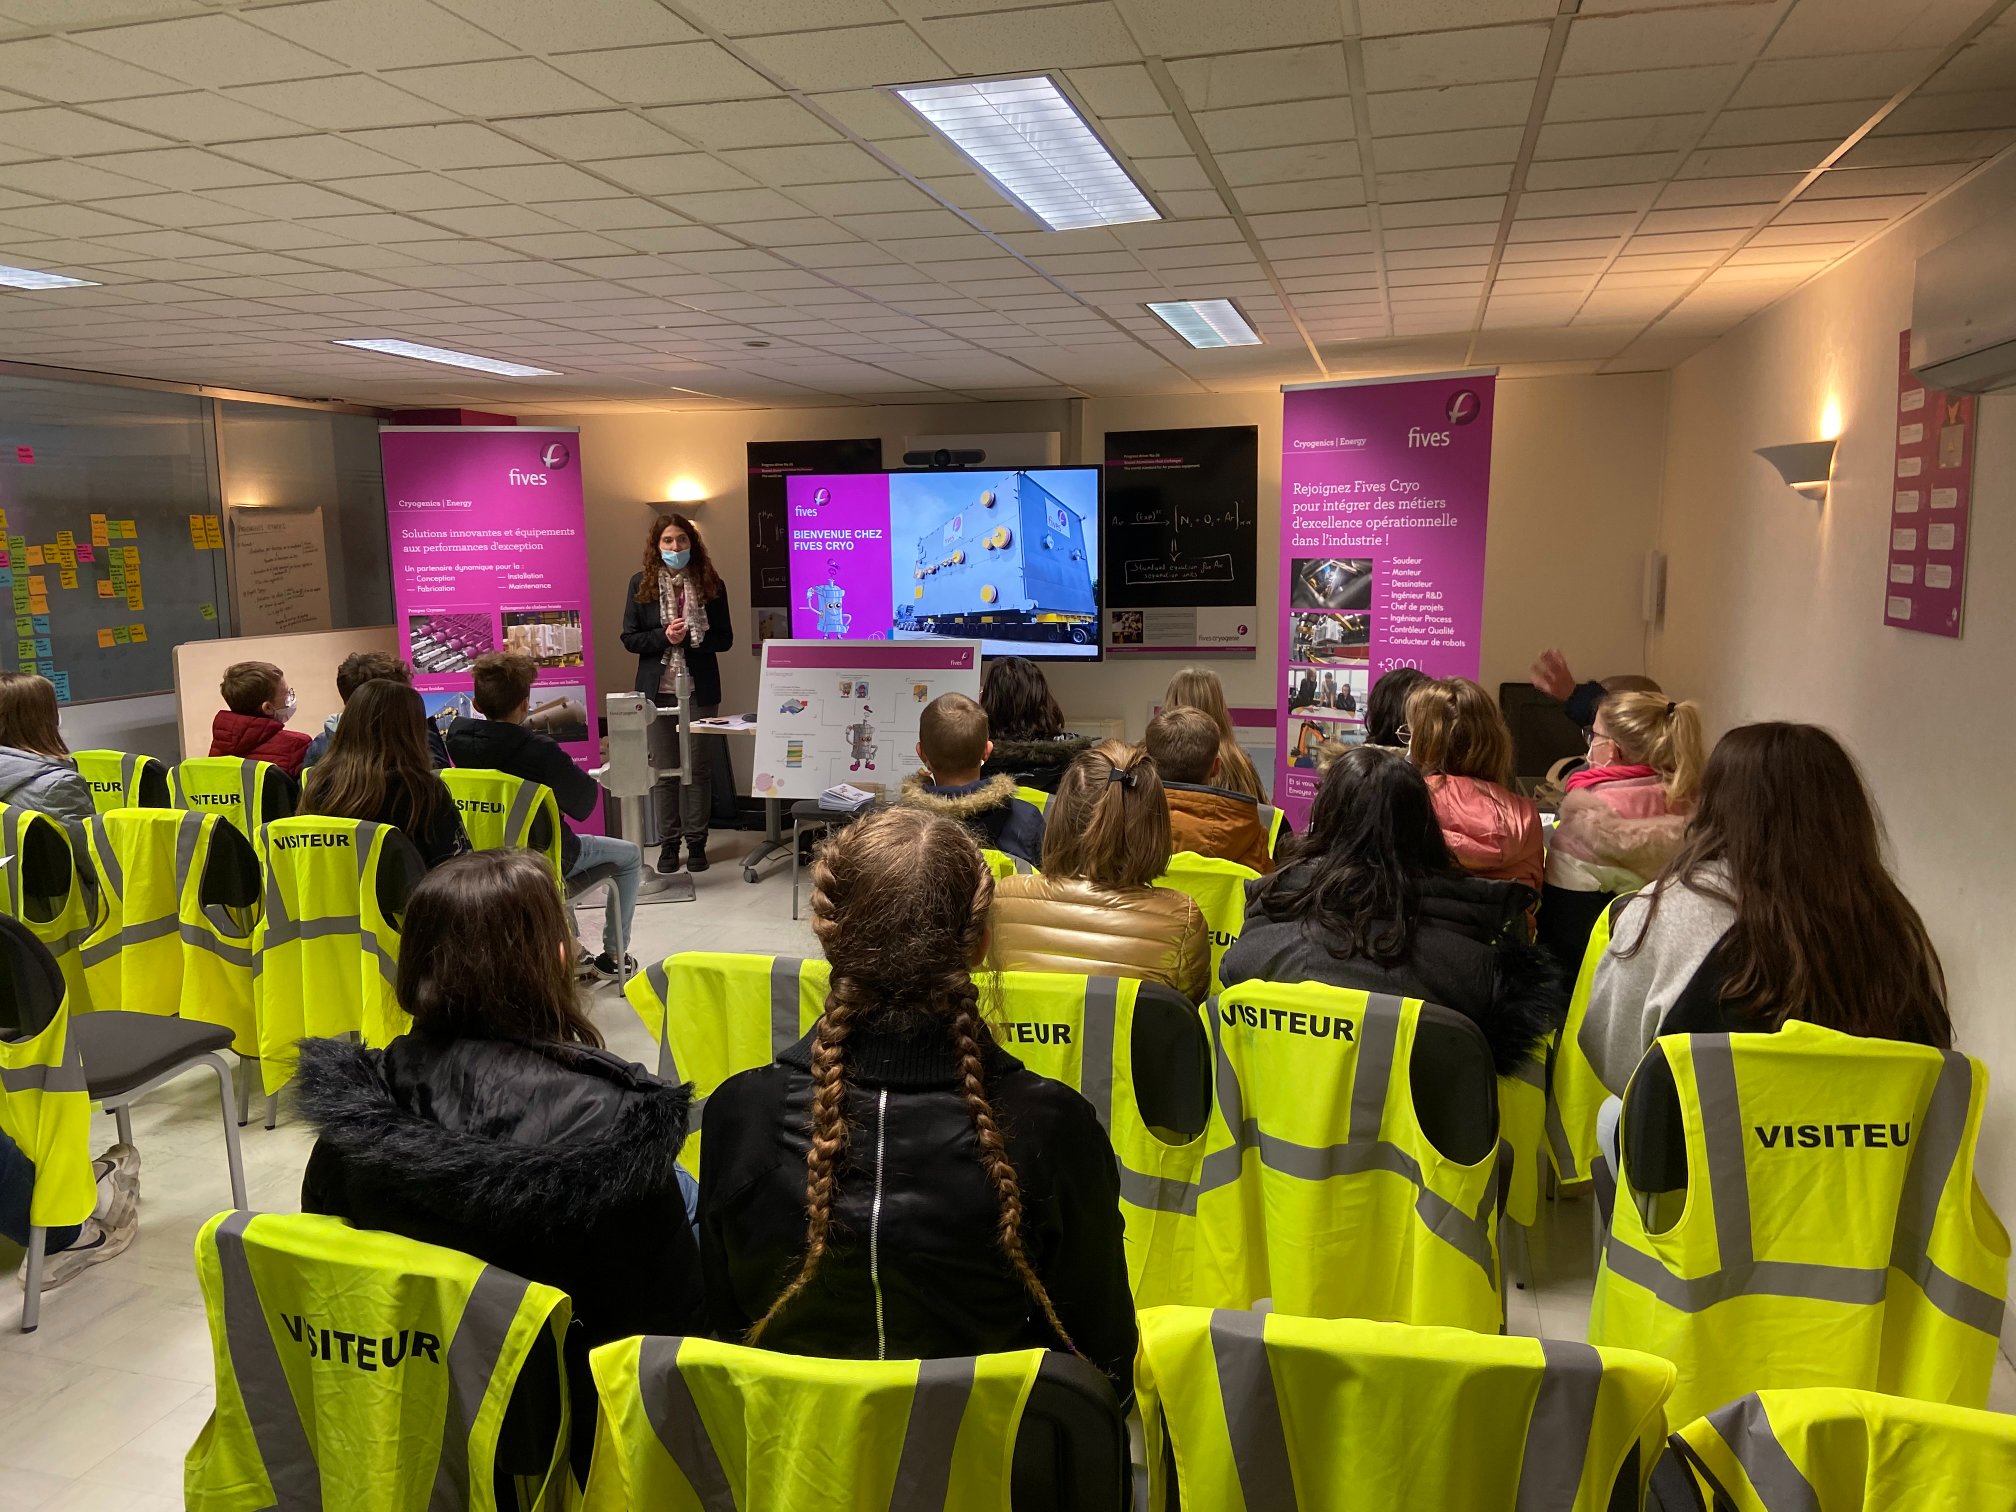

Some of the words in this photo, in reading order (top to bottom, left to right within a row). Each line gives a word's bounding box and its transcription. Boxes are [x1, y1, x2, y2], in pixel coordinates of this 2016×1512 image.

[1408, 427, 1450, 448] fives
[1293, 439, 1334, 449] Cryogenics
[1340, 438, 1367, 446] Energy
[509, 468, 547, 486] fives
[1293, 482, 1351, 497] Rejoignez
[1354, 480, 1386, 492] Fives
[1390, 479, 1420, 494] Cryo
[398, 500, 440, 508] Cryogenics
[446, 500, 472, 508] Energy
[1292, 503, 1320, 514] pour
[1323, 499, 1371, 513] intégrer
[1373, 496, 1395, 510] des
[1398, 497, 1446, 509] métiers
[795, 505, 817, 516] fives
[1292, 515, 1363, 528] d'excellence
[1366, 513, 1458, 530] opérationnelle
[402, 529, 447, 538] Solutions
[450, 529, 502, 537] innovantes
[504, 529, 513, 537] et
[515, 528, 575, 538] équipements
[793, 530, 852, 539] BIENVENUE
[854, 529, 882, 539] CHEZ
[1292, 533, 1319, 545] dans
[423, 542, 488, 554] performances
[490, 541, 543, 552] d'exception
[794, 541, 823, 550] FIVES
[825, 541, 854, 550] CRYO
[1392, 556, 1422, 564] Soudeur
[416, 565, 452, 573] partenaire
[454, 564, 493, 572] dynamique
[416, 575, 455, 583] Conception
[1391, 580, 1432, 588] Dessinateur
[1391, 591, 1423, 600] Ingénieur
[1425, 591, 1443, 599] R&D
[1390, 602, 1407, 610] Chef
[1419, 604, 1444, 612] projets
[1390, 614, 1423, 623] Ingénieur
[1424, 615, 1452, 623] Process
[1389, 625, 1426, 633] Contrôleur
[1427, 626, 1455, 635] Qualité
[1389, 636, 1429, 645] Conducteur
[1430, 638, 1440, 646] de
[1442, 639, 1466, 647] robots
[86, 782, 122, 792] TEUR
[452, 799, 505, 814] SITEU
[273, 834, 350, 850] VISITEUR
[1221, 1004, 1354, 1042] VISITEUR
[999, 1022, 1072, 1044] TEUR
[1754, 1121, 1910, 1148] VISITEU
[280, 1313, 441, 1372] VSITEUR
